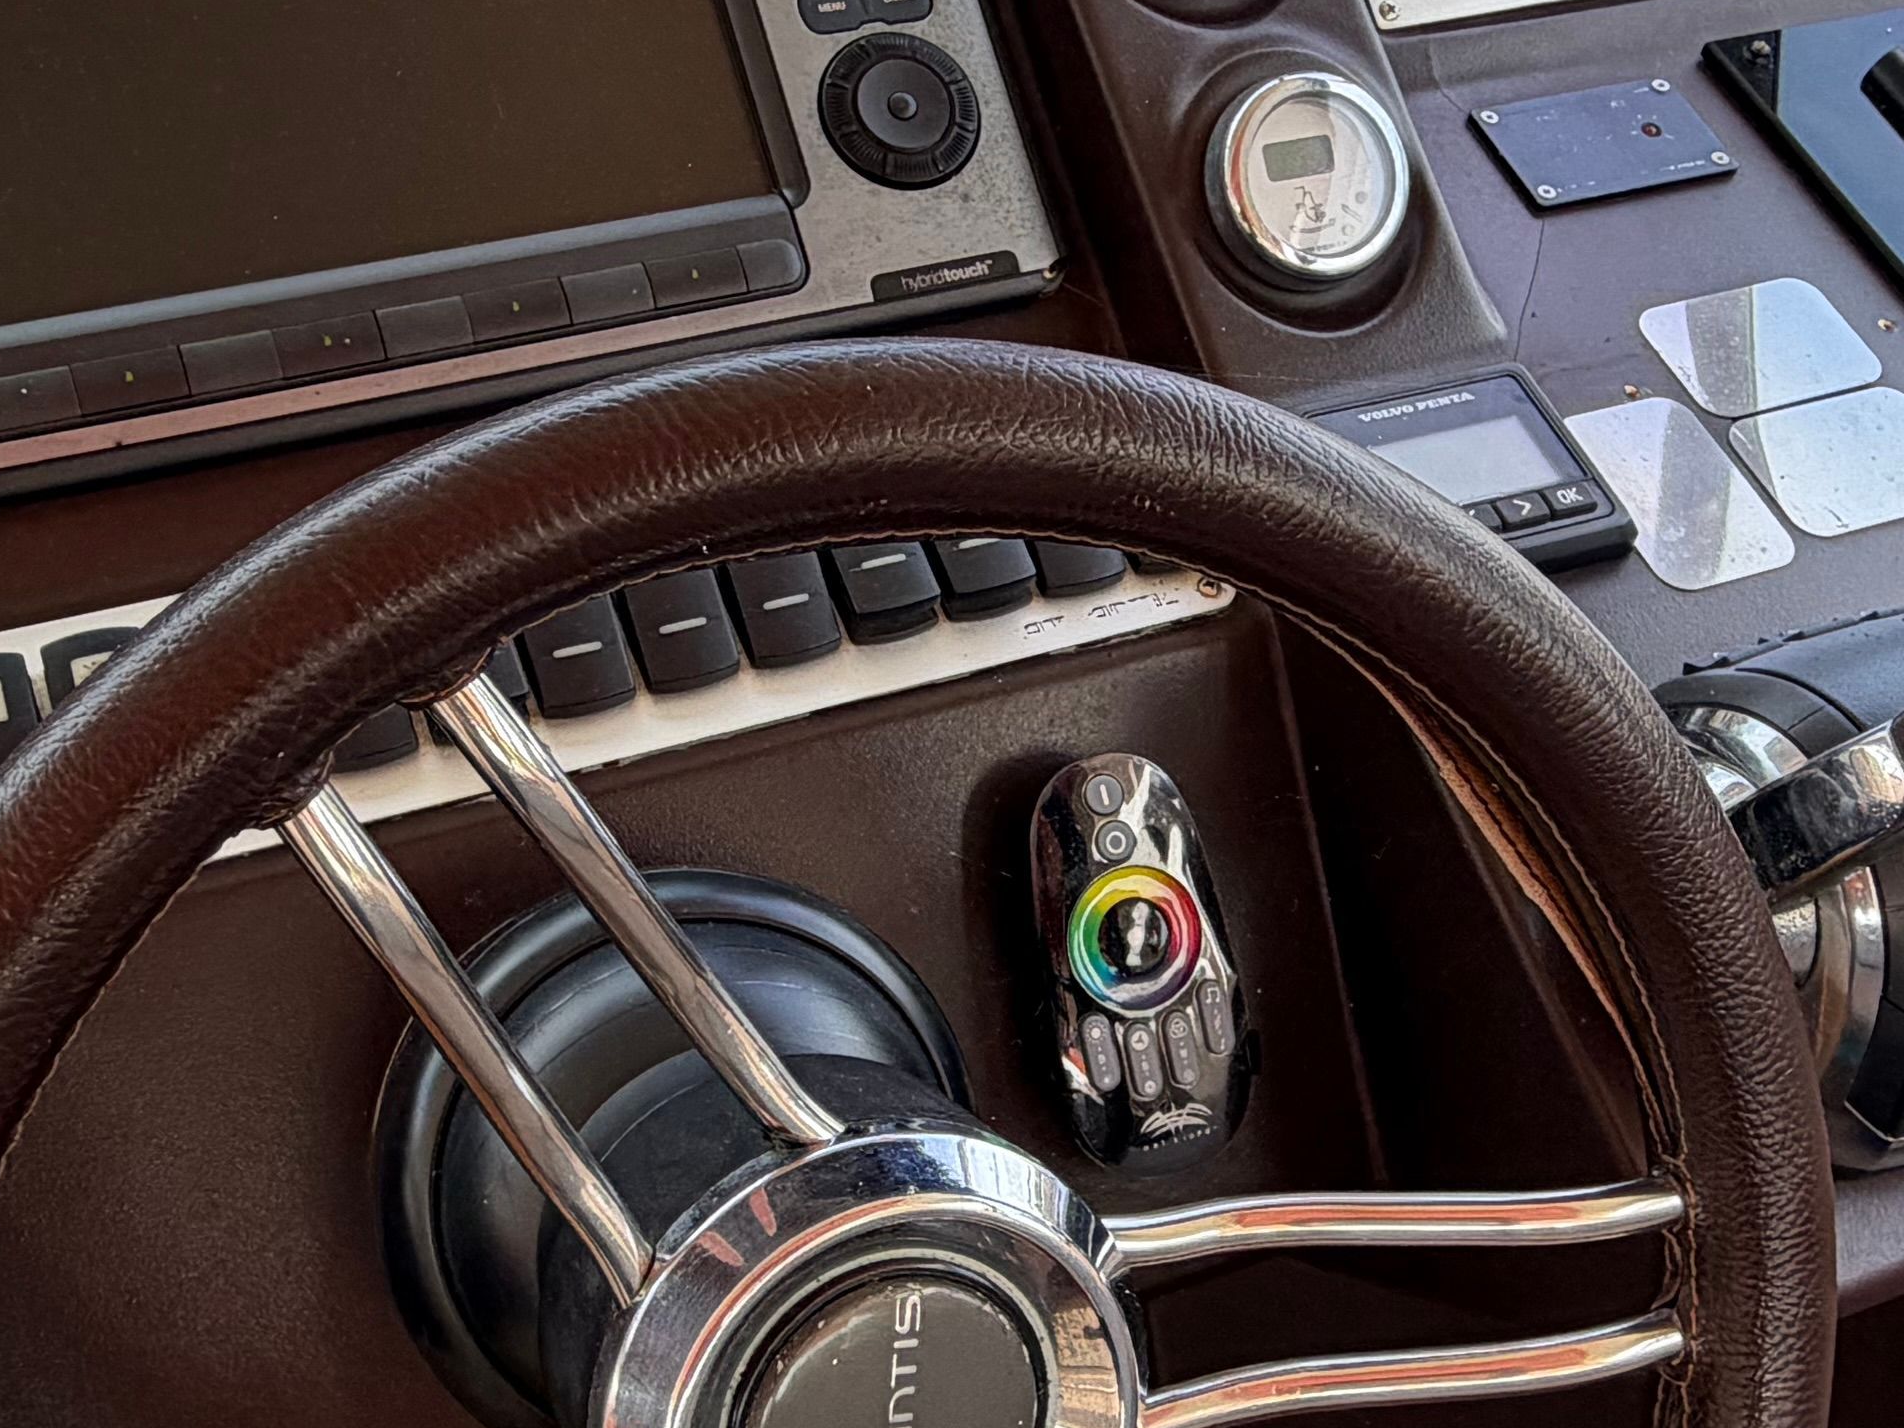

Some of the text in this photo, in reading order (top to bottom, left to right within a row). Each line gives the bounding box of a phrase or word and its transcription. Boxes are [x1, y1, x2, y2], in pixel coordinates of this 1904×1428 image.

[817, 1, 846, 13] MENU
[1358, 392, 1476, 423] VOLVO PENTA
[1556, 487, 1584, 505] OK
